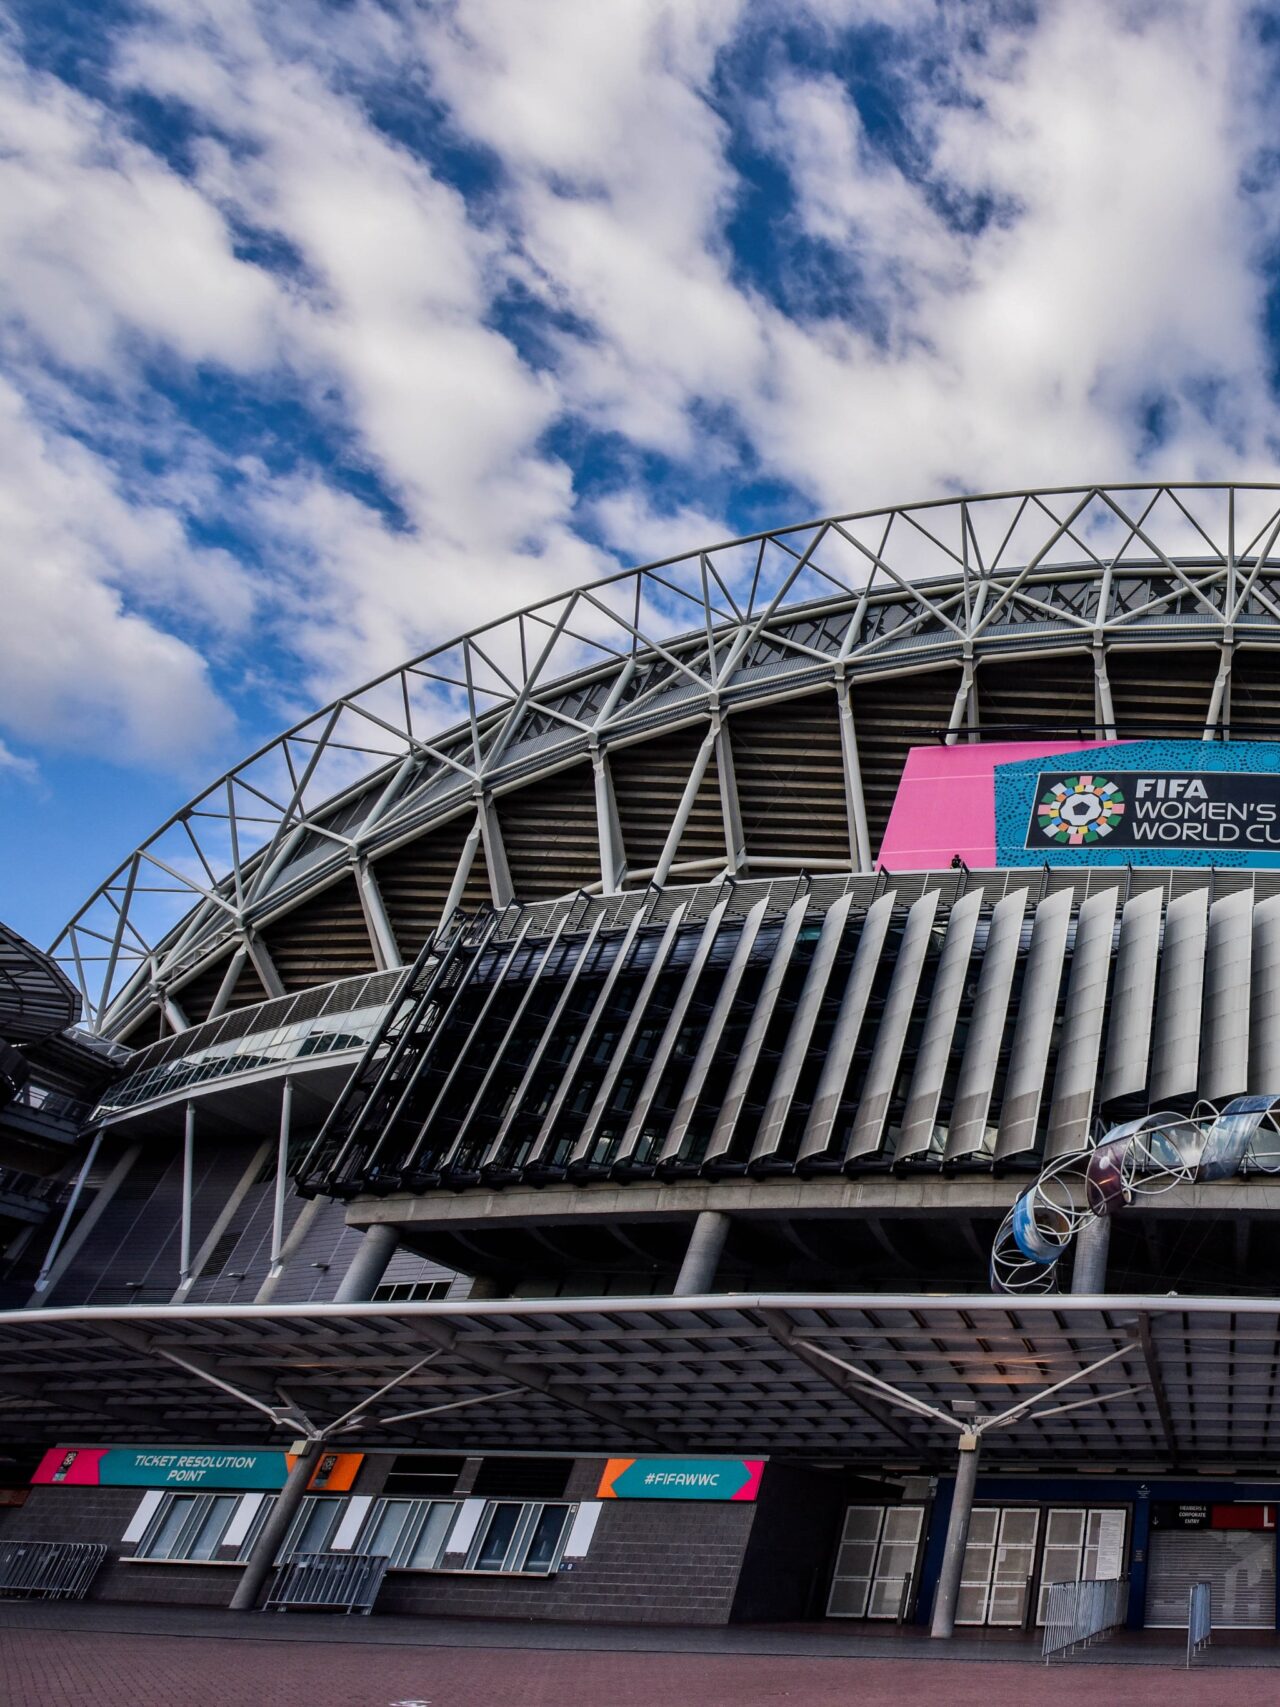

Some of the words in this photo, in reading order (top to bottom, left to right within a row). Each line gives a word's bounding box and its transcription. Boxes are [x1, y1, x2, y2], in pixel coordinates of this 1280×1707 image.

[1135, 779, 1208, 799] FIFA
[1134, 801, 1276, 822] WOMEN'S
[1132, 822, 1239, 843] WORLD
[134, 1455, 176, 1467] TICKET
[178, 1456, 256, 1469] RESOLUTION
[166, 1469, 206, 1482] POINT
[644, 1472, 720, 1487] #FIFAWWC
[1263, 1505, 1275, 1527] L
